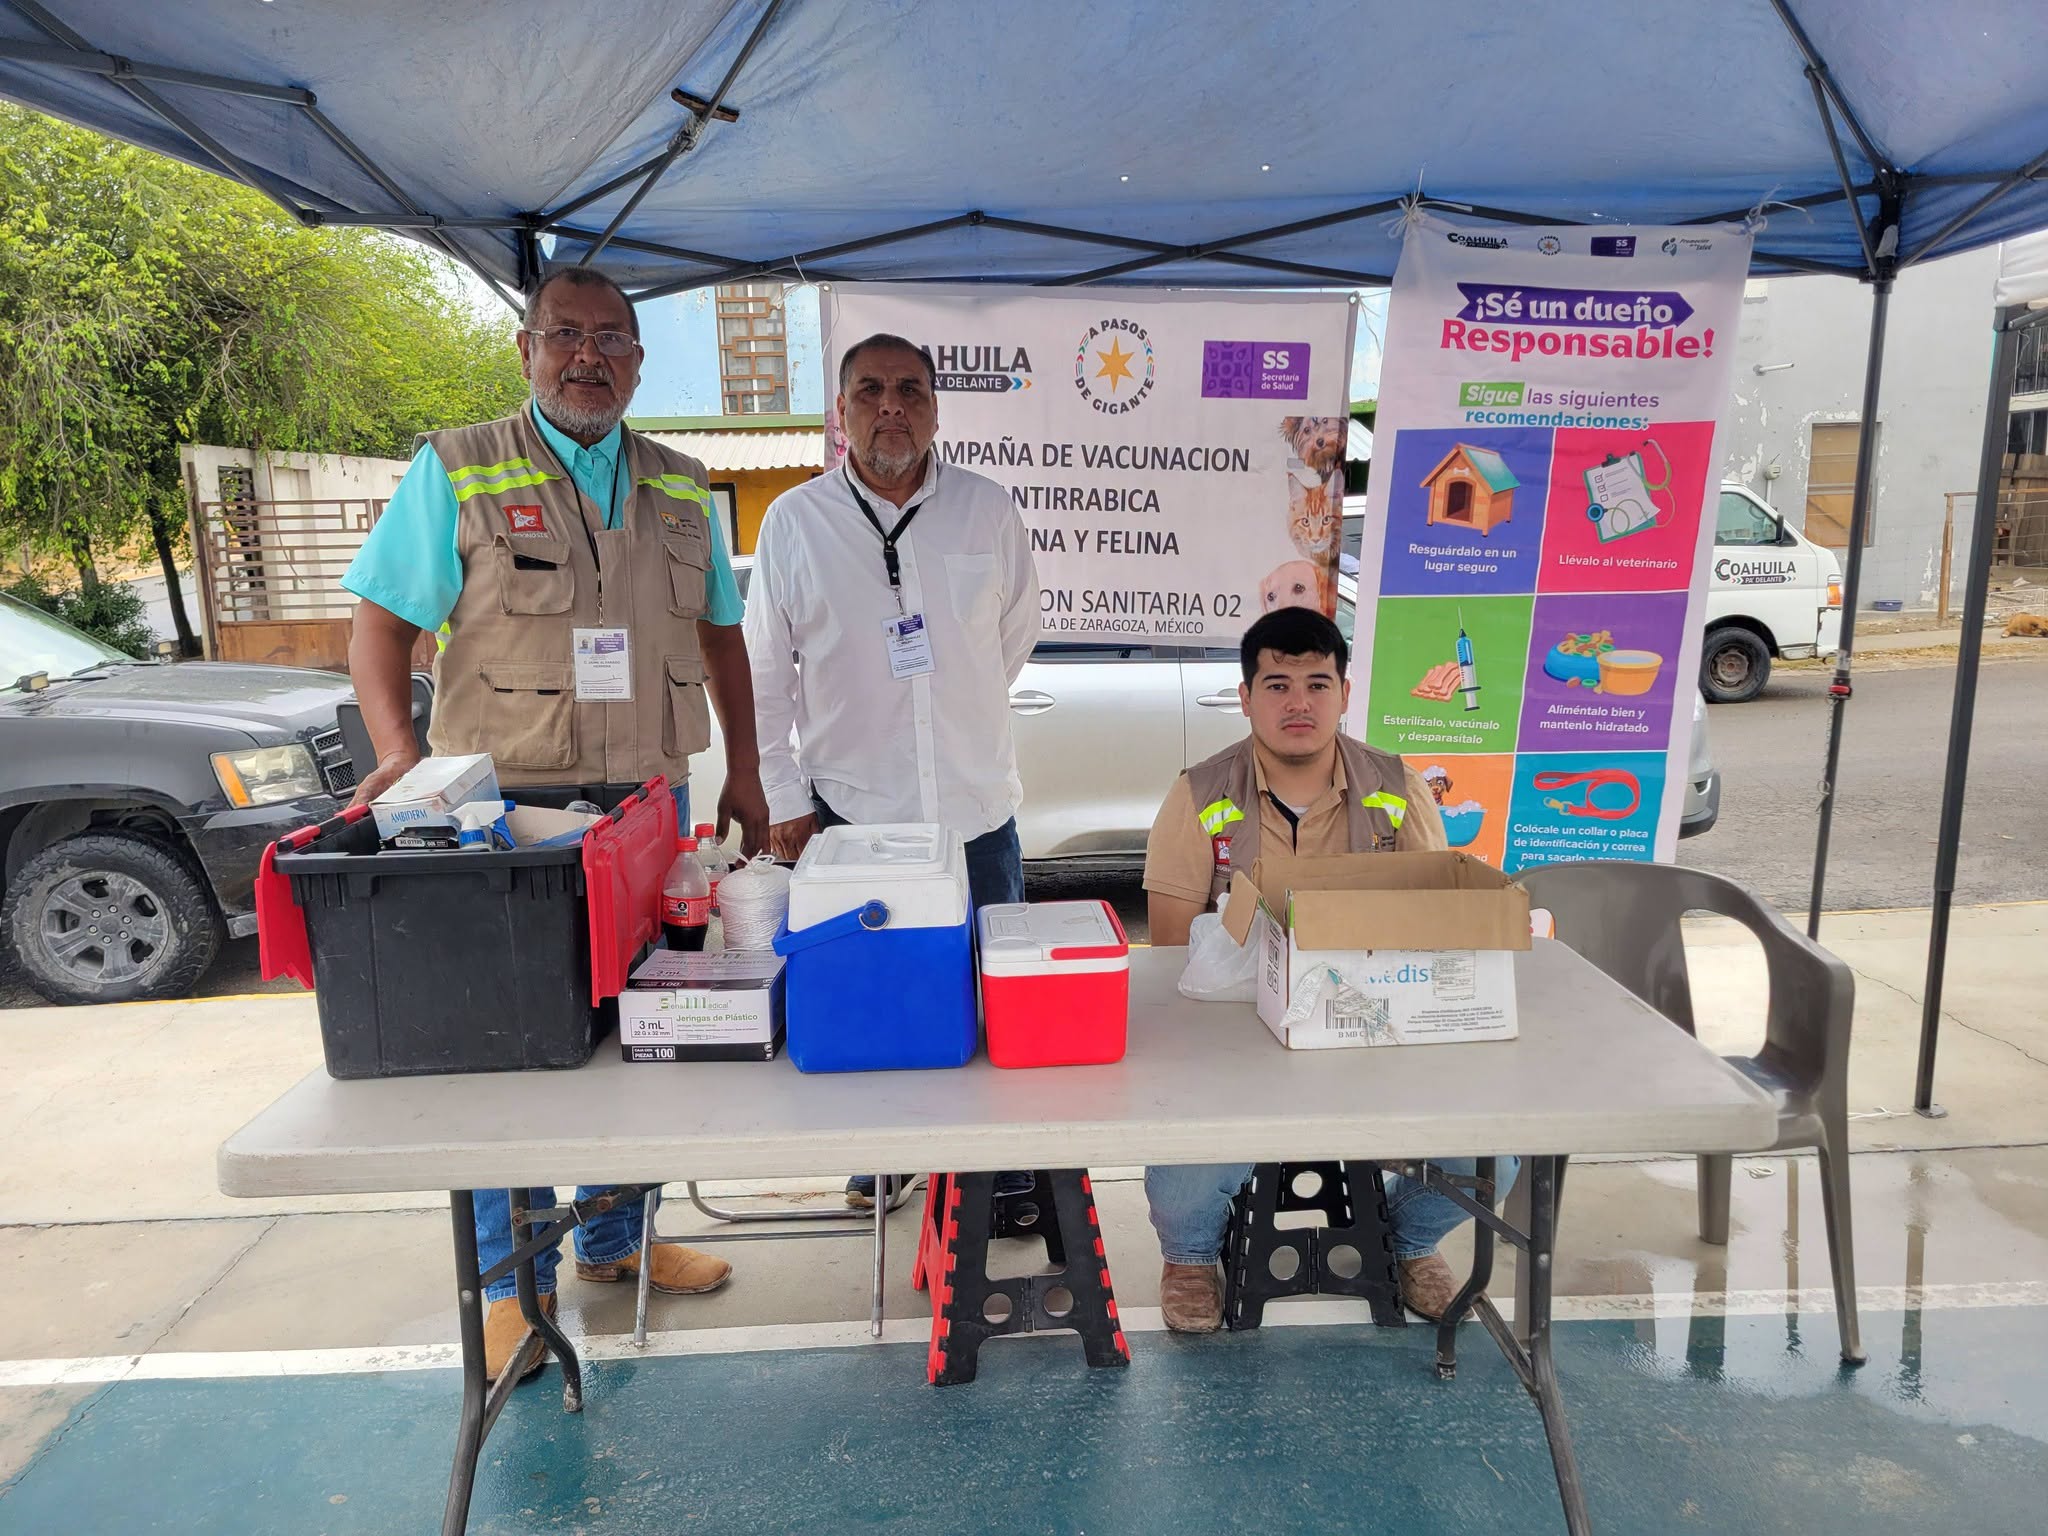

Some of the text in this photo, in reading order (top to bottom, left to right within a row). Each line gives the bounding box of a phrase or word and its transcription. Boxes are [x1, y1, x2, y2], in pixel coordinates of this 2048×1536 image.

[1447, 232, 1508, 246] COAHUILA
[1616, 239, 1628, 247] SS
[1475, 292, 1673, 323] ¡Sé un dueño
[1089, 318, 1148, 341] A PASOS
[1440, 318, 1715, 362] Responsable!
[1263, 350, 1290, 369] SS
[947, 377, 1002, 388] DELANTE
[1262, 373, 1300, 382] Secretaría
[1261, 382, 1294, 390] de Salud
[1075, 376, 1154, 414] DE GIGANTE
[1465, 385, 1660, 410] Sigue las siguientes
[1465, 409, 1649, 429] recomendaciones:
[1042, 443, 1074, 468] DE
[1081, 444, 1250, 472] VACUNACION
[1002, 485, 1160, 513] NTIRRABICA
[1074, 529, 1089, 552] Y
[1097, 530, 1180, 555] FELINA
[1409, 543, 1517, 558] Resguárdalo en un
[1424, 560, 1498, 574] lugar seguro
[1559, 554, 1678, 569] Llévalo al veterinario
[1714, 559, 1796, 581] COAHUILA
[1082, 590, 1205, 616] SANITARIA
[1213, 594, 1242, 618] 02
[1060, 617, 1076, 630] DE
[1080, 618, 1150, 634] ZARAGOZA,
[1155, 617, 1204, 634] MÉXICO
[1547, 704, 1645, 720] Aliméntalo bien y
[1383, 715, 1500, 730] Esterilízalo, vacúnalo
[1540, 721, 1649, 733] mantenlo hidratado
[1398, 732, 1483, 744] y desparasítalo
[391, 809, 428, 823] AMBIDERM
[1513, 824, 1559, 834] Colócale
[1562, 827, 1576, 835] un
[1578, 826, 1607, 837] collar
[1619, 829, 1649, 839] placa
[1513, 838, 1646, 852] de identificación y correa
[1521, 852, 1545, 861] para
[676, 1014, 711, 1022] Jeringas
[725, 1013, 758, 1021] Plástico
[639, 1021, 664, 1030] 3 mL
[655, 1048, 673, 1058] 100
